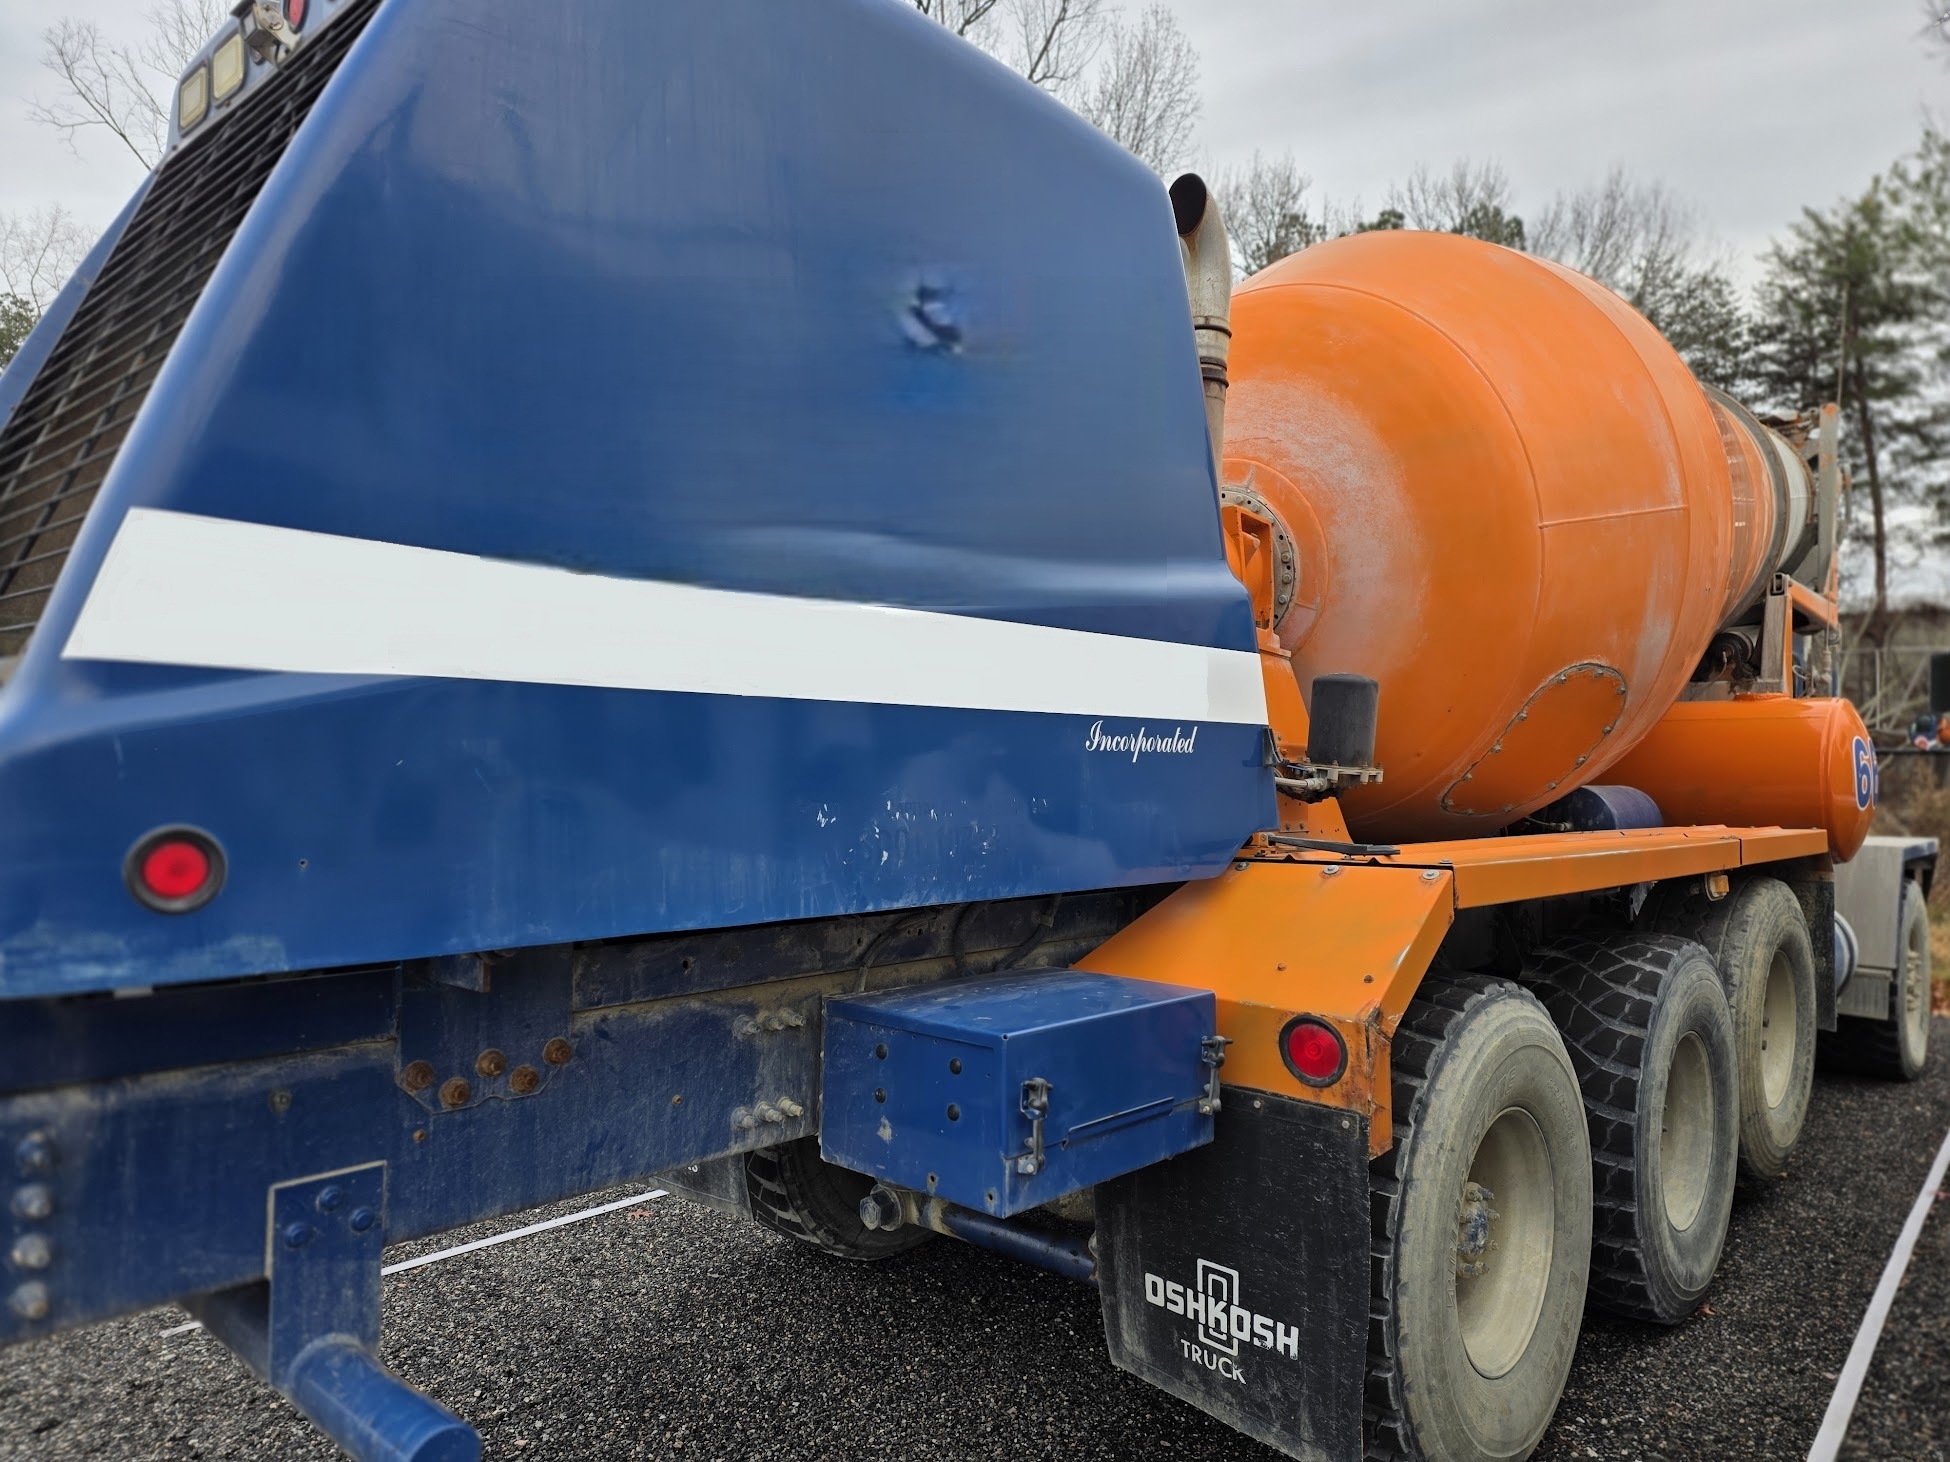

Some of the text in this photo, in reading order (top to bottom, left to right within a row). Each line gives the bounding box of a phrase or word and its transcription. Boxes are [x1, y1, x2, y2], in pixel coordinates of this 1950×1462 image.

[1085, 719, 1198, 763] Incorporated
[1144, 1272, 1299, 1360] OSHKOSH
[1180, 1338, 1247, 1385] TRUCK
